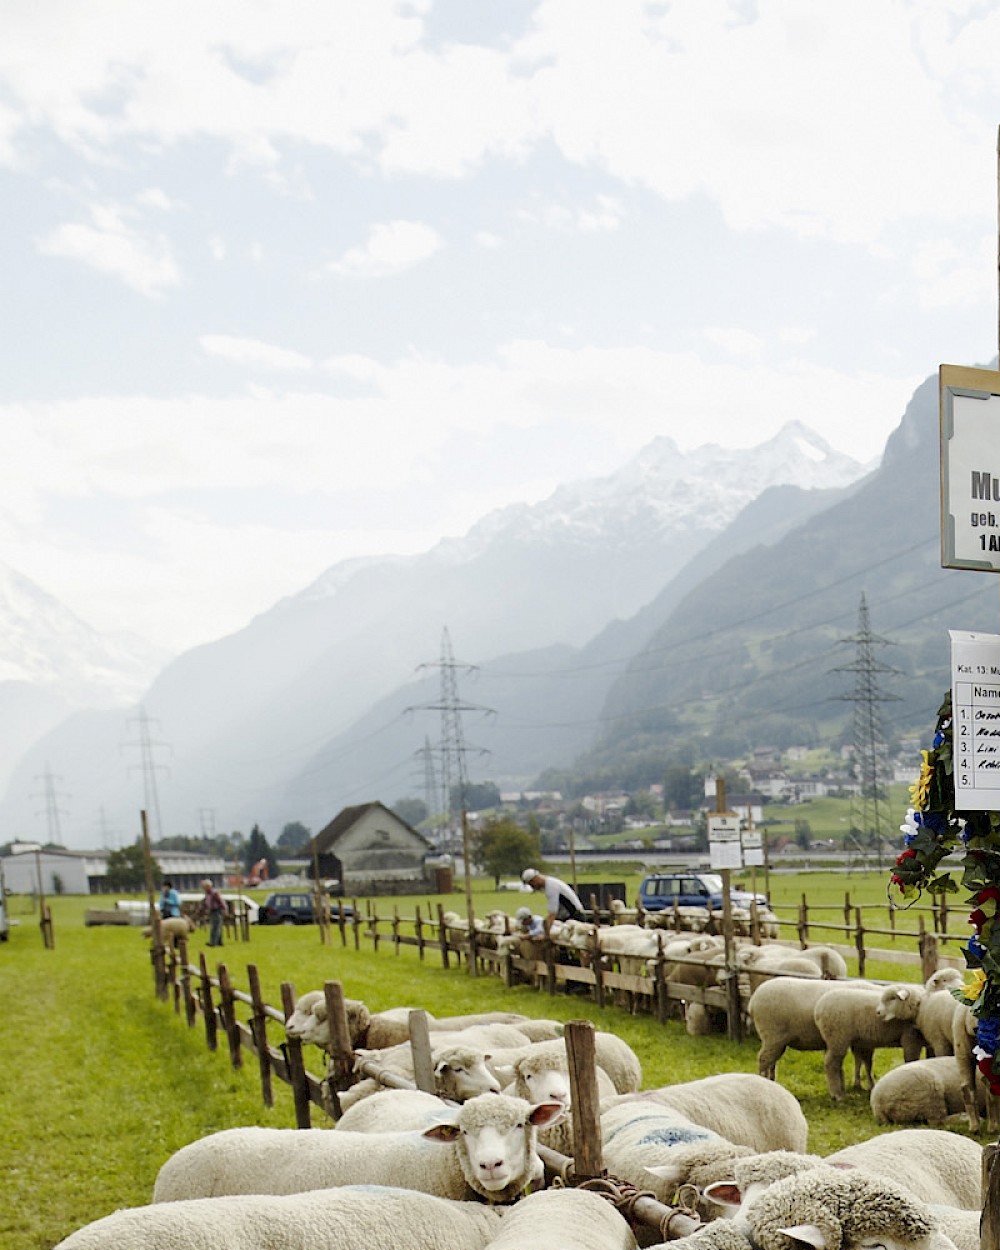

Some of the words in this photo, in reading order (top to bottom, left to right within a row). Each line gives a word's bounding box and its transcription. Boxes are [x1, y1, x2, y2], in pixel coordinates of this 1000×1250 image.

[971, 512, 998, 528] geb.
[980, 535, 986, 551] 1
[957, 664, 973, 674] Kat.
[977, 665, 988, 674] 13:
[961, 709, 970, 720] 1.
[960, 725, 970, 736] 2.
[960, 741, 971, 752] 3.
[960, 759, 971, 769] 4.
[962, 774, 971, 786] 5.
